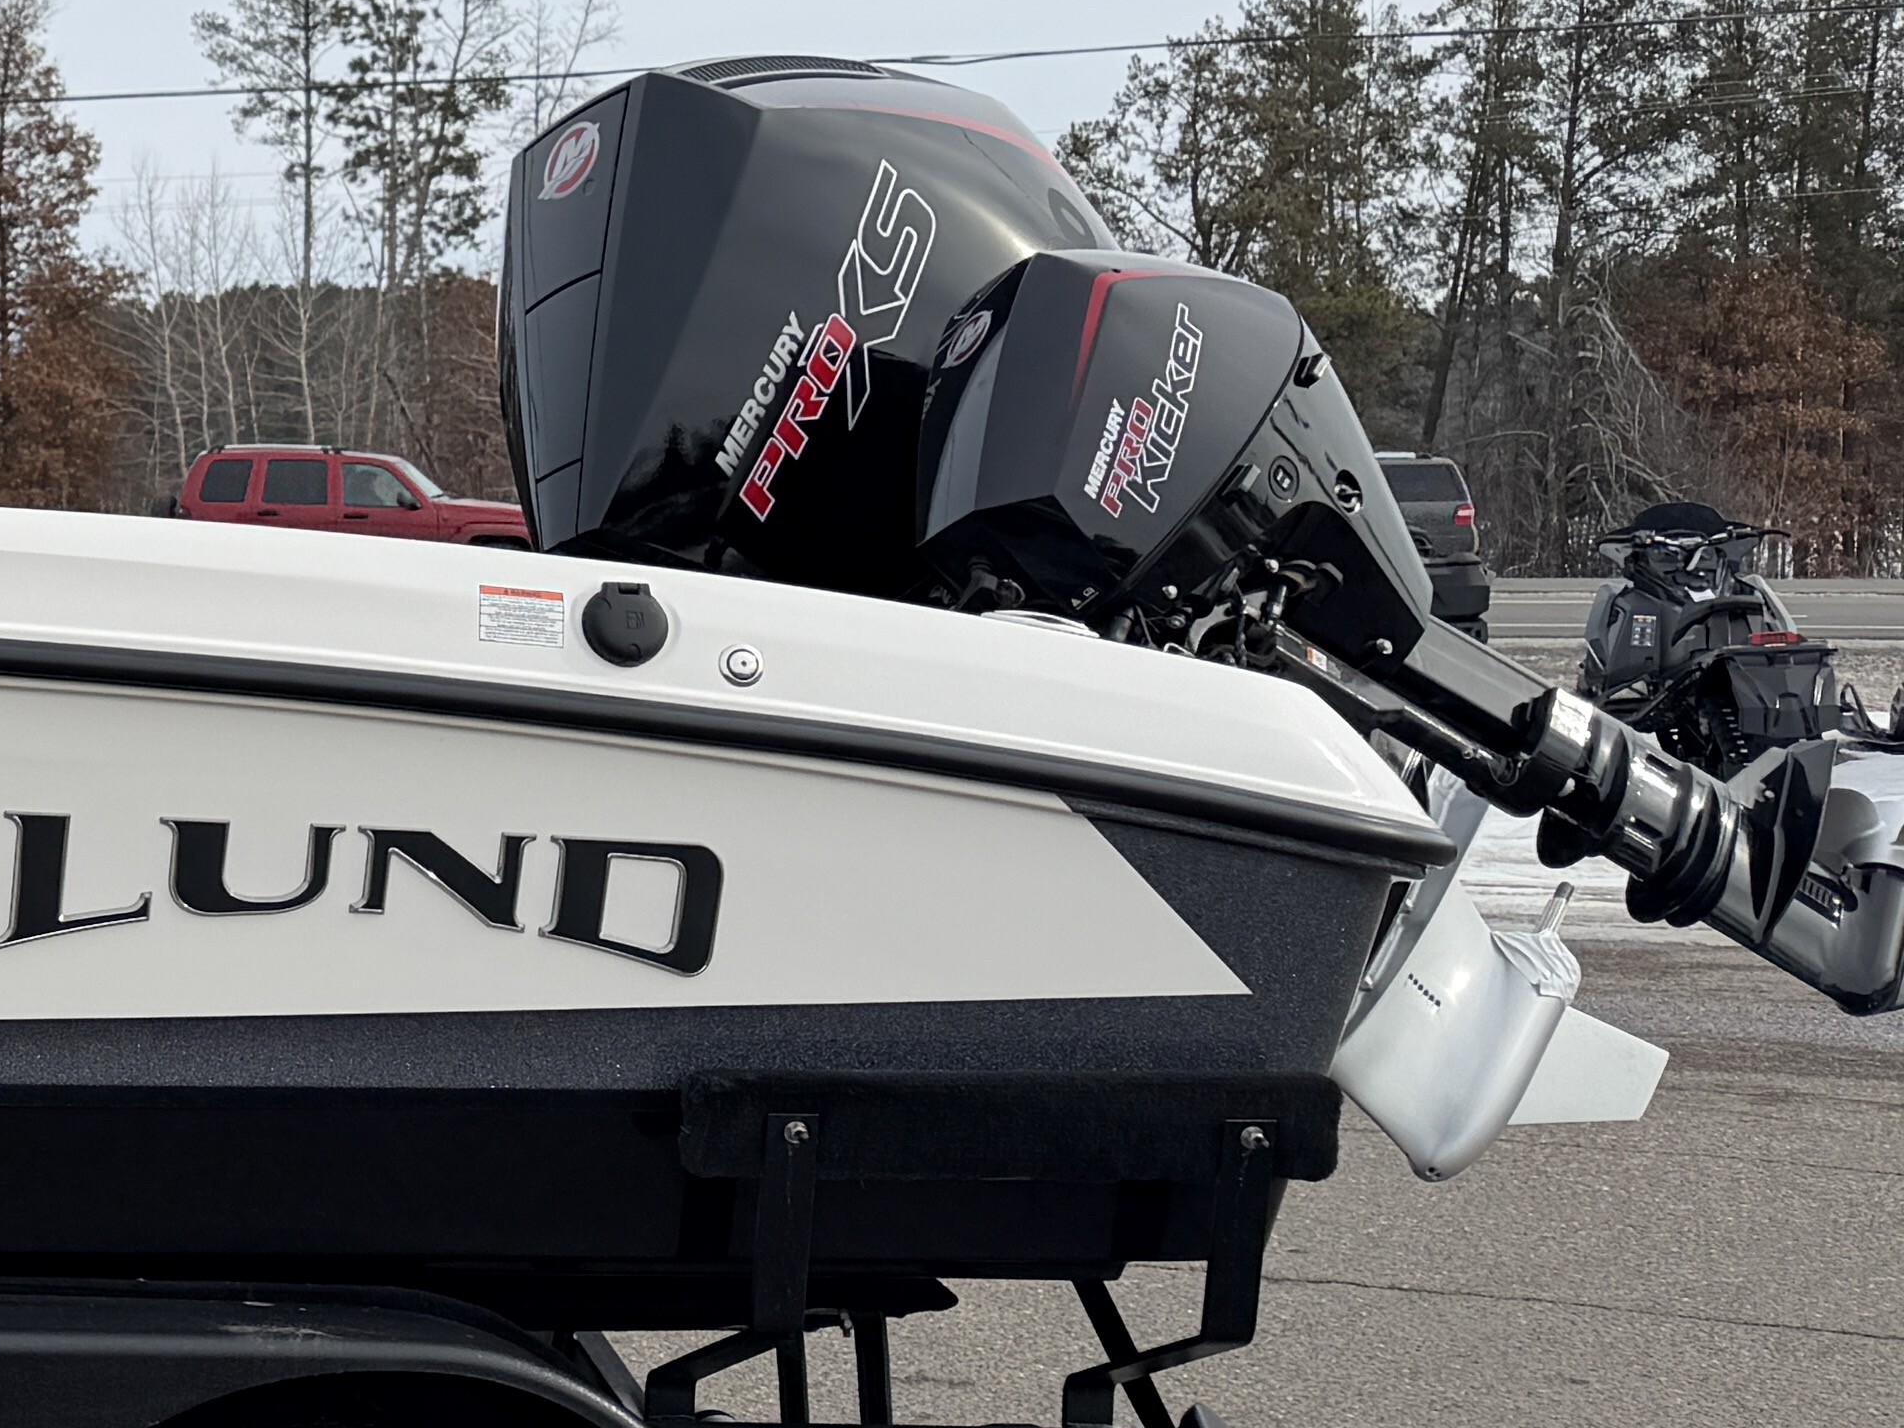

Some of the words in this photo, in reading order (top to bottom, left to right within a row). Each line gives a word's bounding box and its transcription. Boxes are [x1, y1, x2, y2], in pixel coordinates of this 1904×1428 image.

[714, 311, 805, 477] MERCURY
[739, 313, 856, 522] PRO
[798, 159, 936, 431] XS
[1083, 397, 1126, 500] MERCURY
[1100, 397, 1154, 518] PRO
